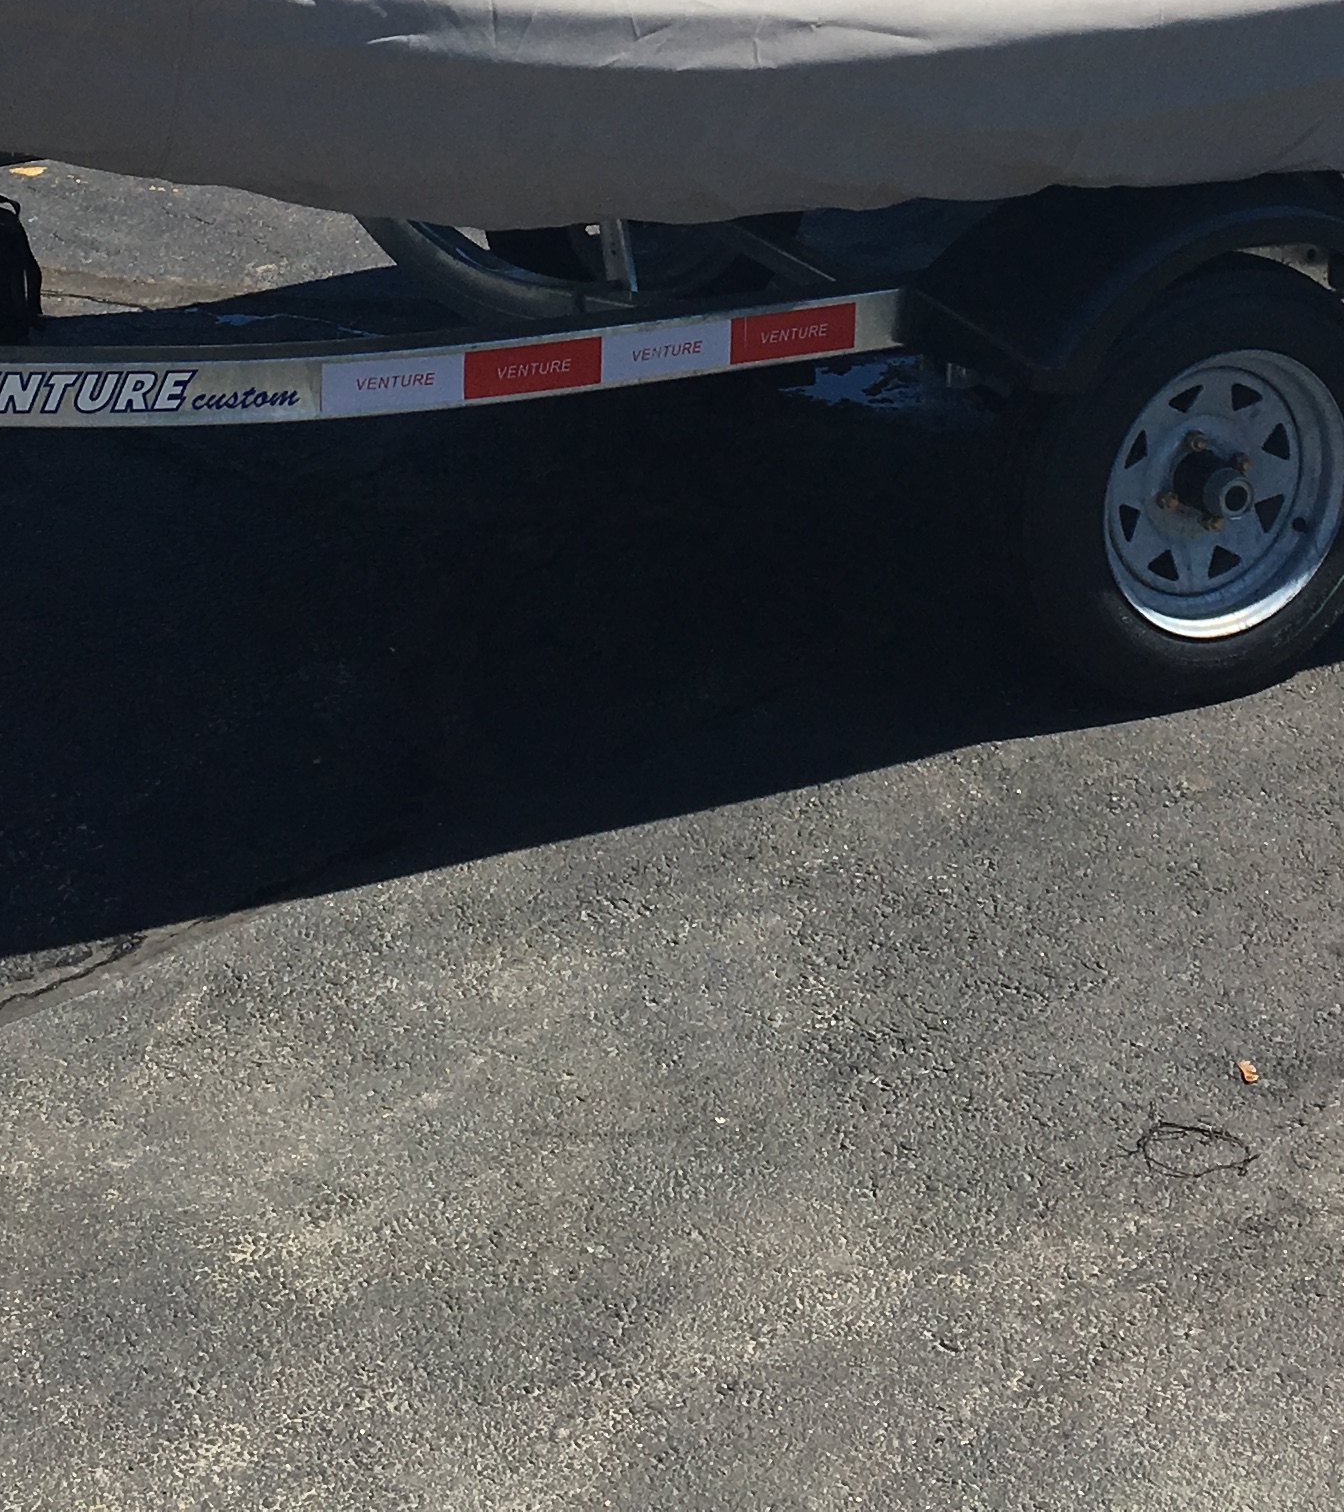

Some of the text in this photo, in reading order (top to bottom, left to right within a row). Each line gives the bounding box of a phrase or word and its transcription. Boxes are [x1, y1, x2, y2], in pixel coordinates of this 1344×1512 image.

[760, 323, 829, 344] VENTURE
[631, 340, 703, 362] VENTURE
[496, 358, 572, 380] VENTURE
[356, 372, 436, 391] VENTURE
[191, 386, 299, 411] custom
